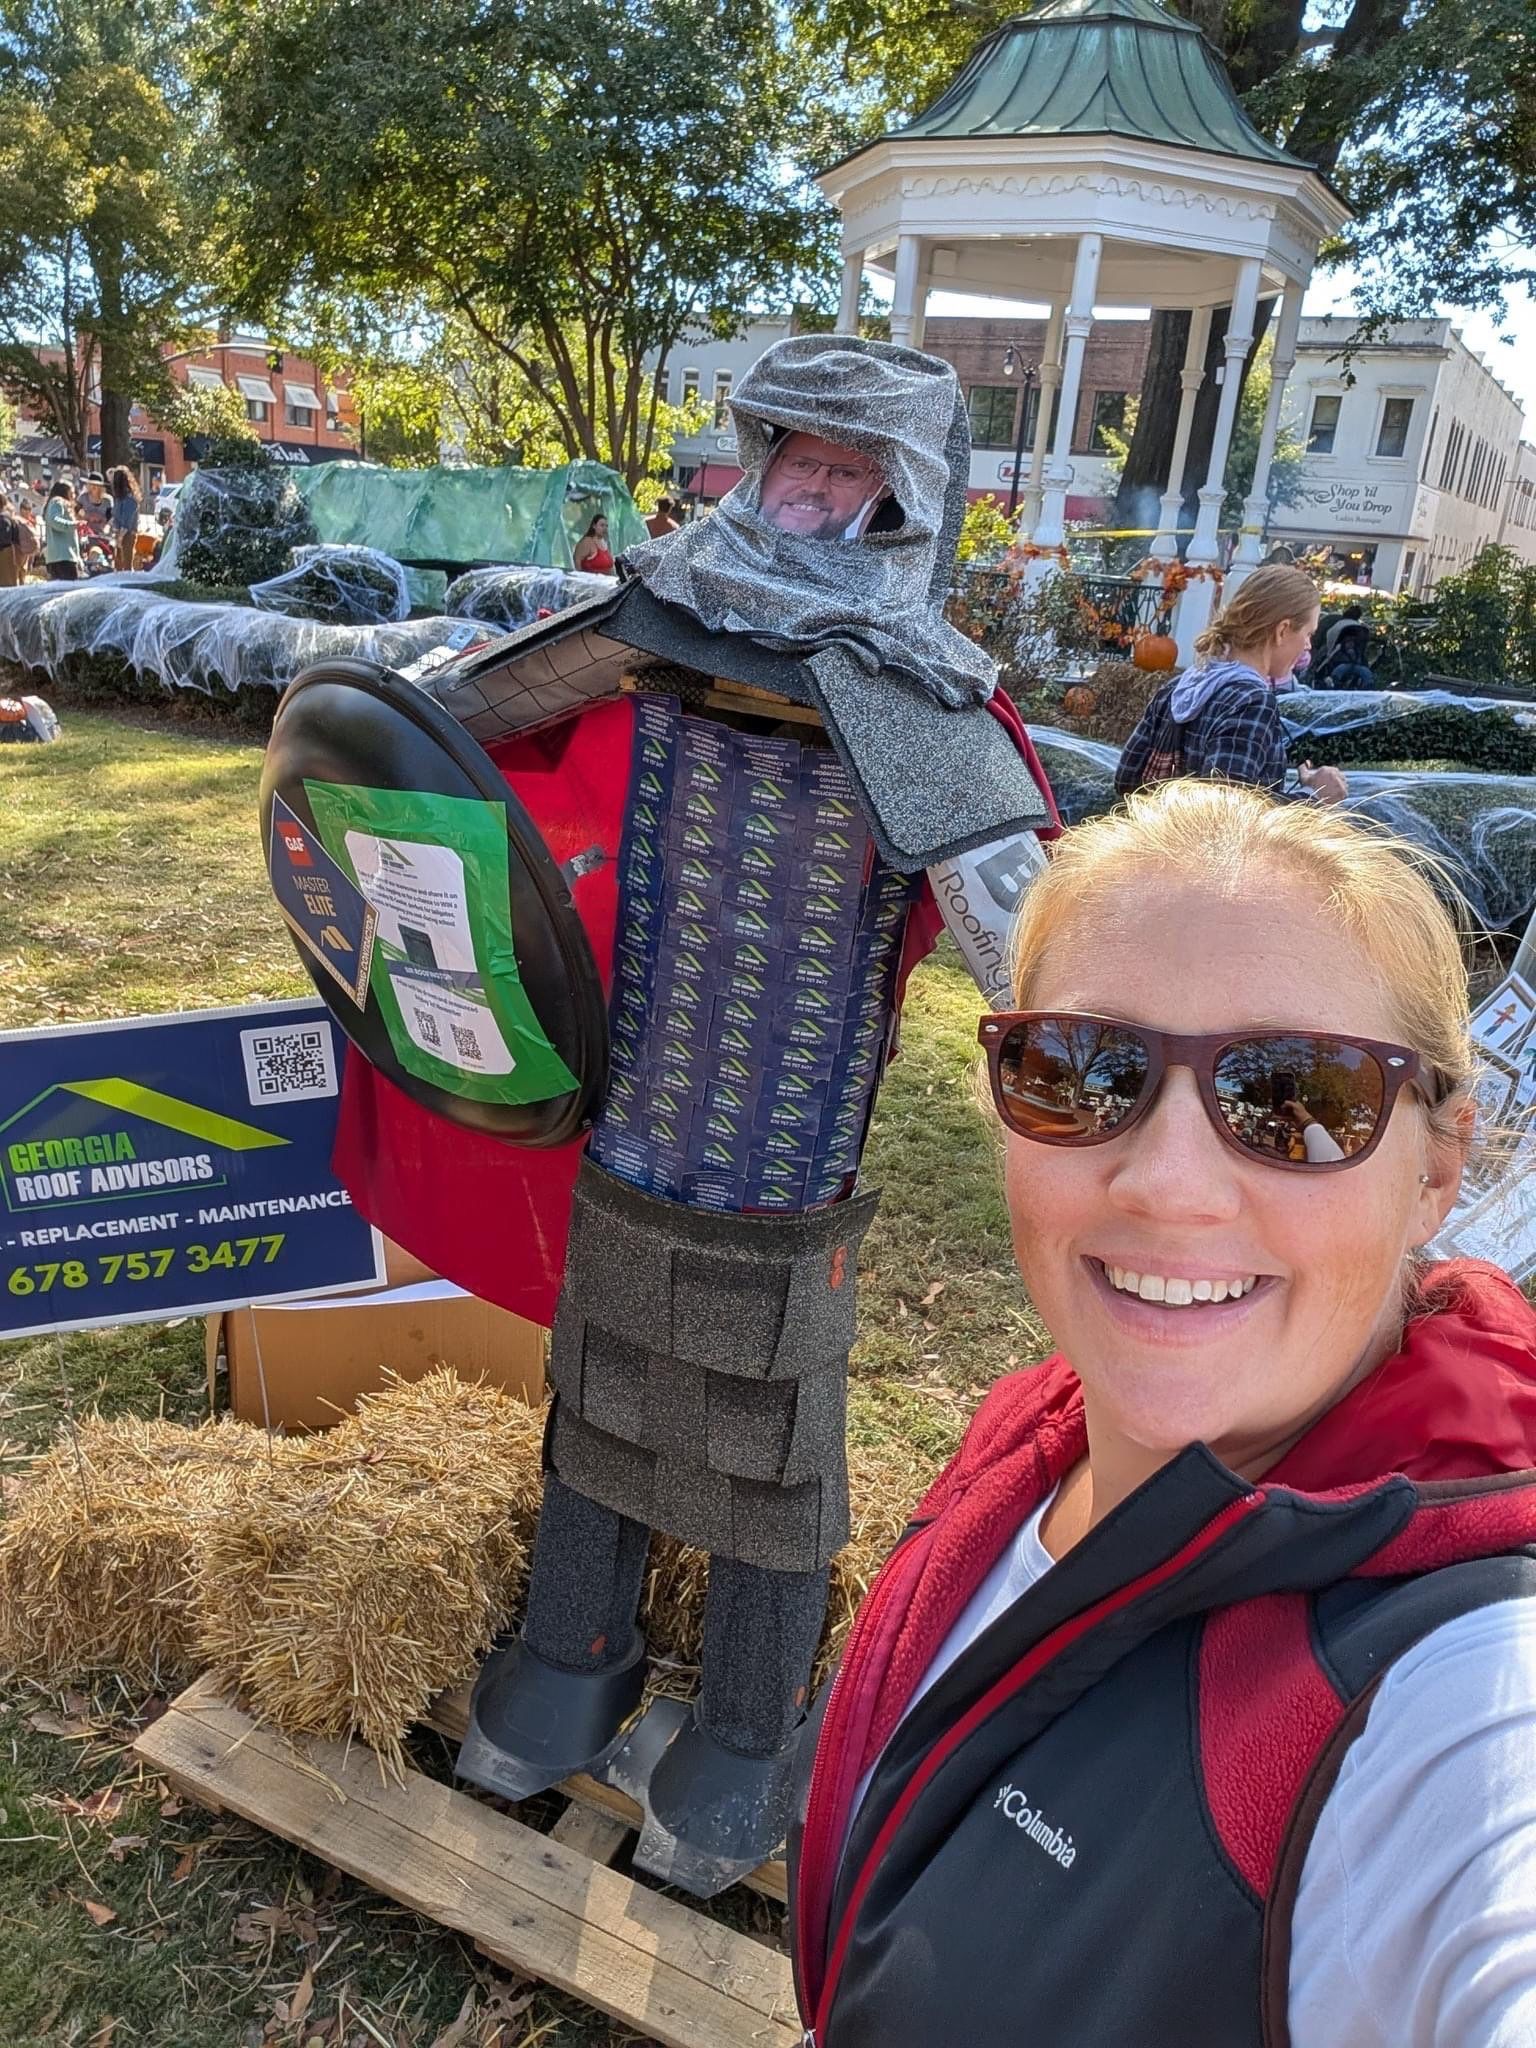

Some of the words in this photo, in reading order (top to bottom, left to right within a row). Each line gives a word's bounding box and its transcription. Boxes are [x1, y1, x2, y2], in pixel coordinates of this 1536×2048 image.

[1314, 484, 1359, 503] Shop
[1329, 499, 1360, 513] You
[1363, 500, 1392, 515] Drop
[285, 837, 305, 852] GAF
[292, 875, 331, 893] MASTER
[304, 894, 337, 917] ELITE
[7, 1131, 136, 1174] GEORGIA
[15, 1169, 82, 1202] ROOF
[90, 1154, 214, 1194] ADVISORS
[22, 1212, 180, 1247] REPLACEMENT
[199, 1190, 353, 1226] MAINTENANCE
[7, 1261, 89, 1296] 678
[99, 1248, 175, 1285] 757
[186, 1233, 286, 1274] 3477
[1003, 1790, 1076, 1869] Columbia
